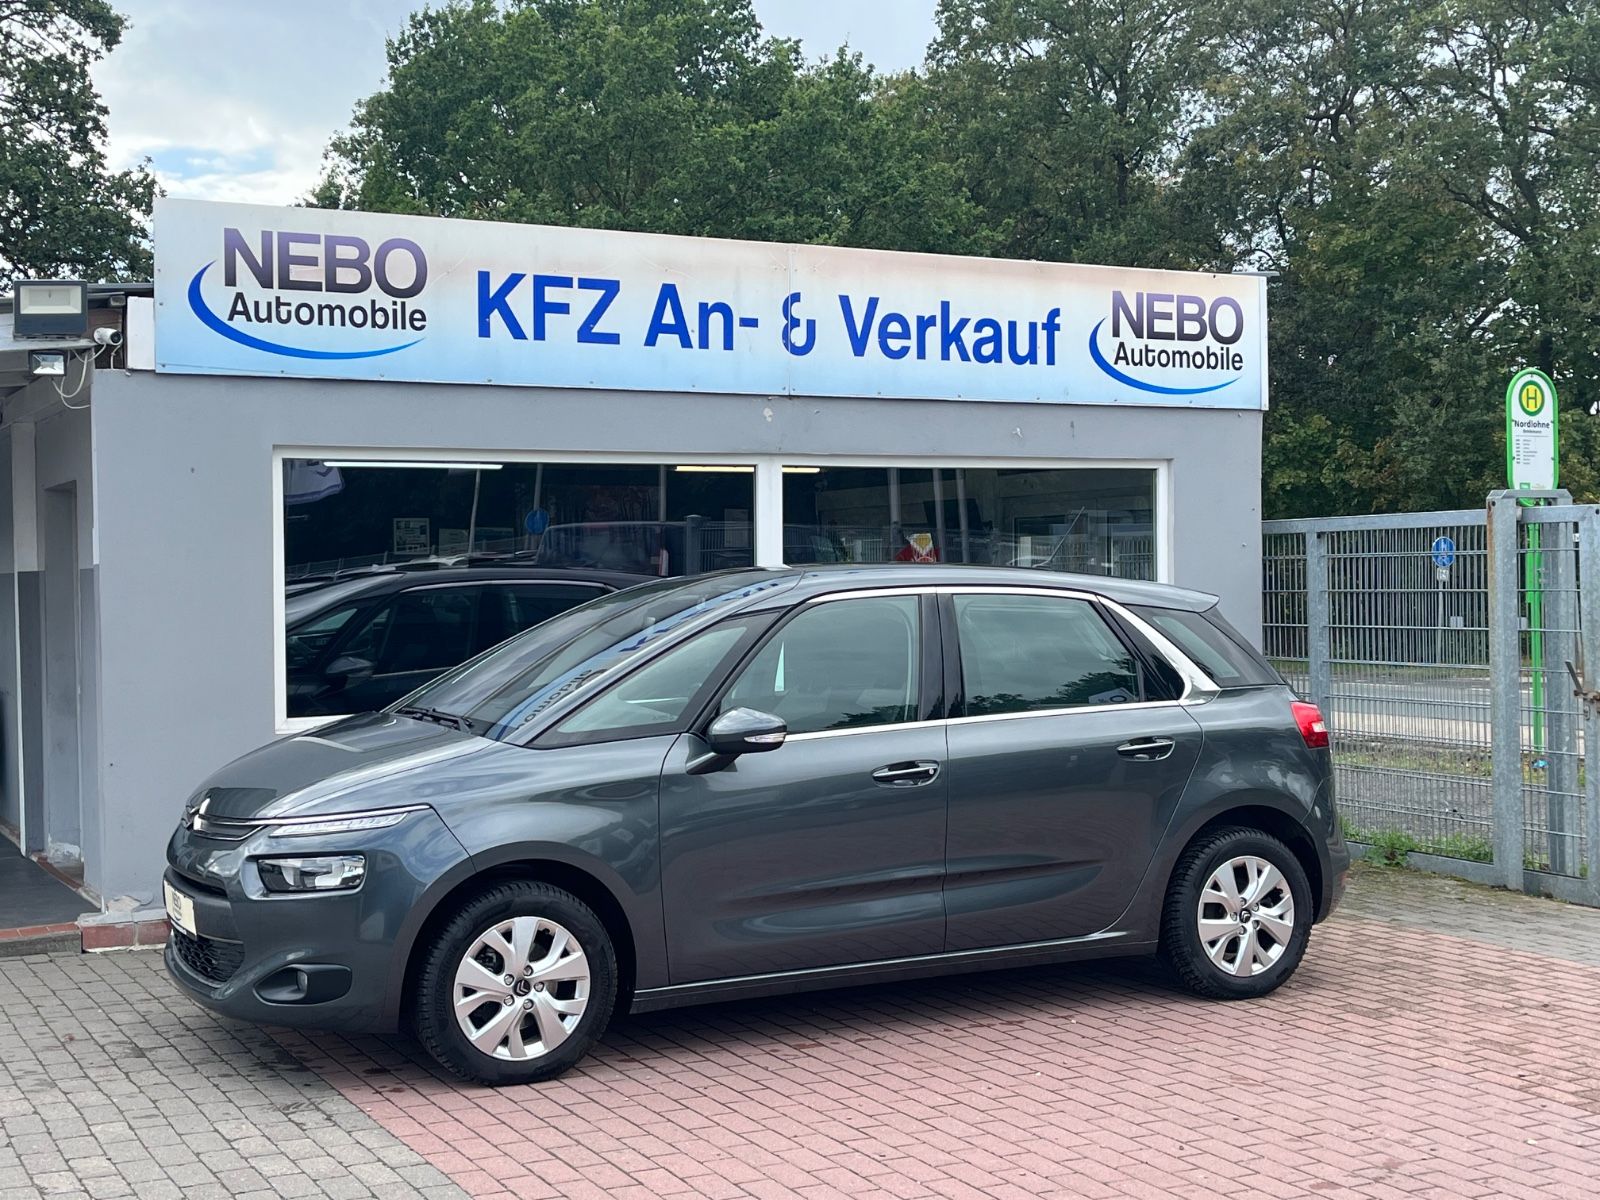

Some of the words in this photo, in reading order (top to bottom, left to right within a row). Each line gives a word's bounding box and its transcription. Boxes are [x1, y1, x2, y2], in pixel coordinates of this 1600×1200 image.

[224, 227, 428, 299] NEBO
[227, 291, 428, 332] Automobile
[477, 270, 621, 345] KFZ
[643, 282, 759, 352] An-
[781, 291, 817, 357] &
[837, 294, 1061, 367] Verkauf
[1111, 290, 1245, 346] NEBO
[1112, 341, 1244, 372] Automobile
[1526, 387, 1538, 409] H
[1514, 420, 1550, 429] Nordlohne
